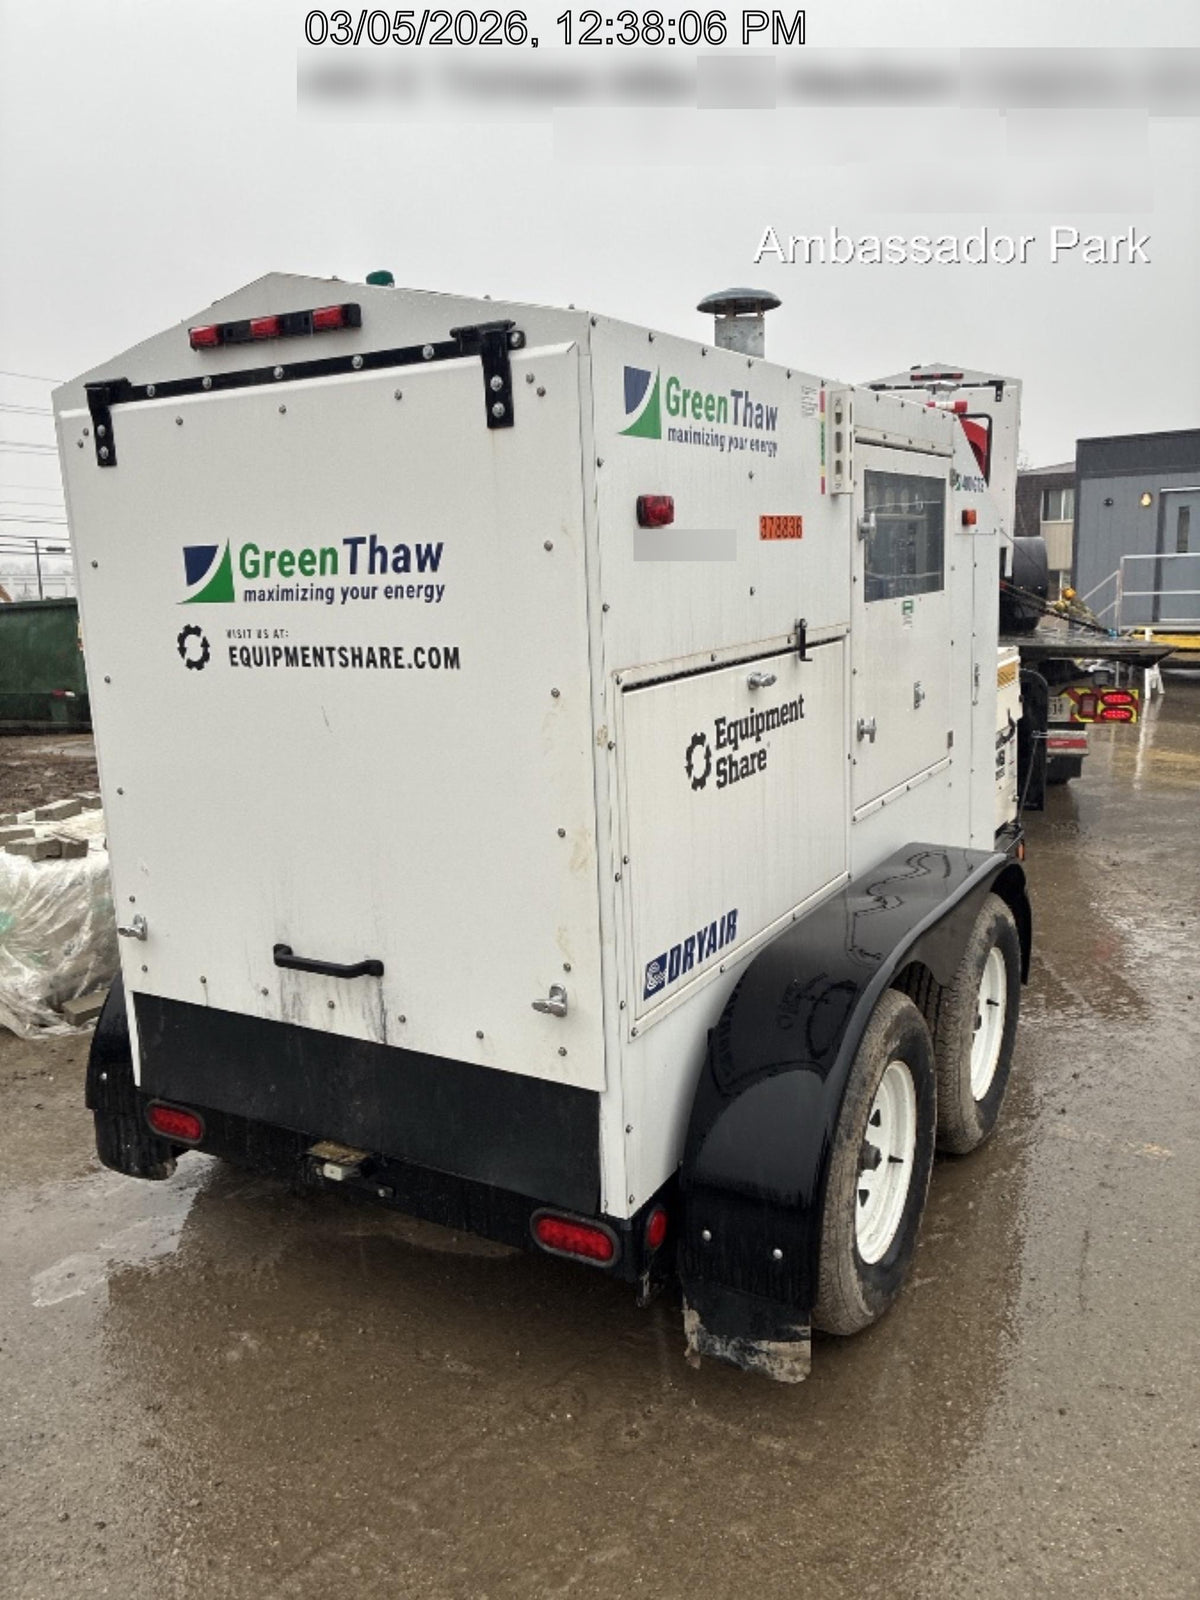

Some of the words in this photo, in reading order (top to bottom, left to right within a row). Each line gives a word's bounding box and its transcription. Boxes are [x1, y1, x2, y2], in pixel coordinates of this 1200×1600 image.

[668, 426, 725, 452] maximizing
[750, 440, 777, 458] energy
[244, 583, 334, 605] maximizing
[340, 586, 378, 605] your
[384, 582, 446, 603] energy
[225, 628, 252, 639] VISIT
[273, 628, 289, 639] AT:
[229, 646, 461, 669] EQUIPMENTSHARE.COM
[714, 694, 805, 750] Equipment
[716, 747, 767, 789] Share
[667, 908, 738, 984] DRYAIR
